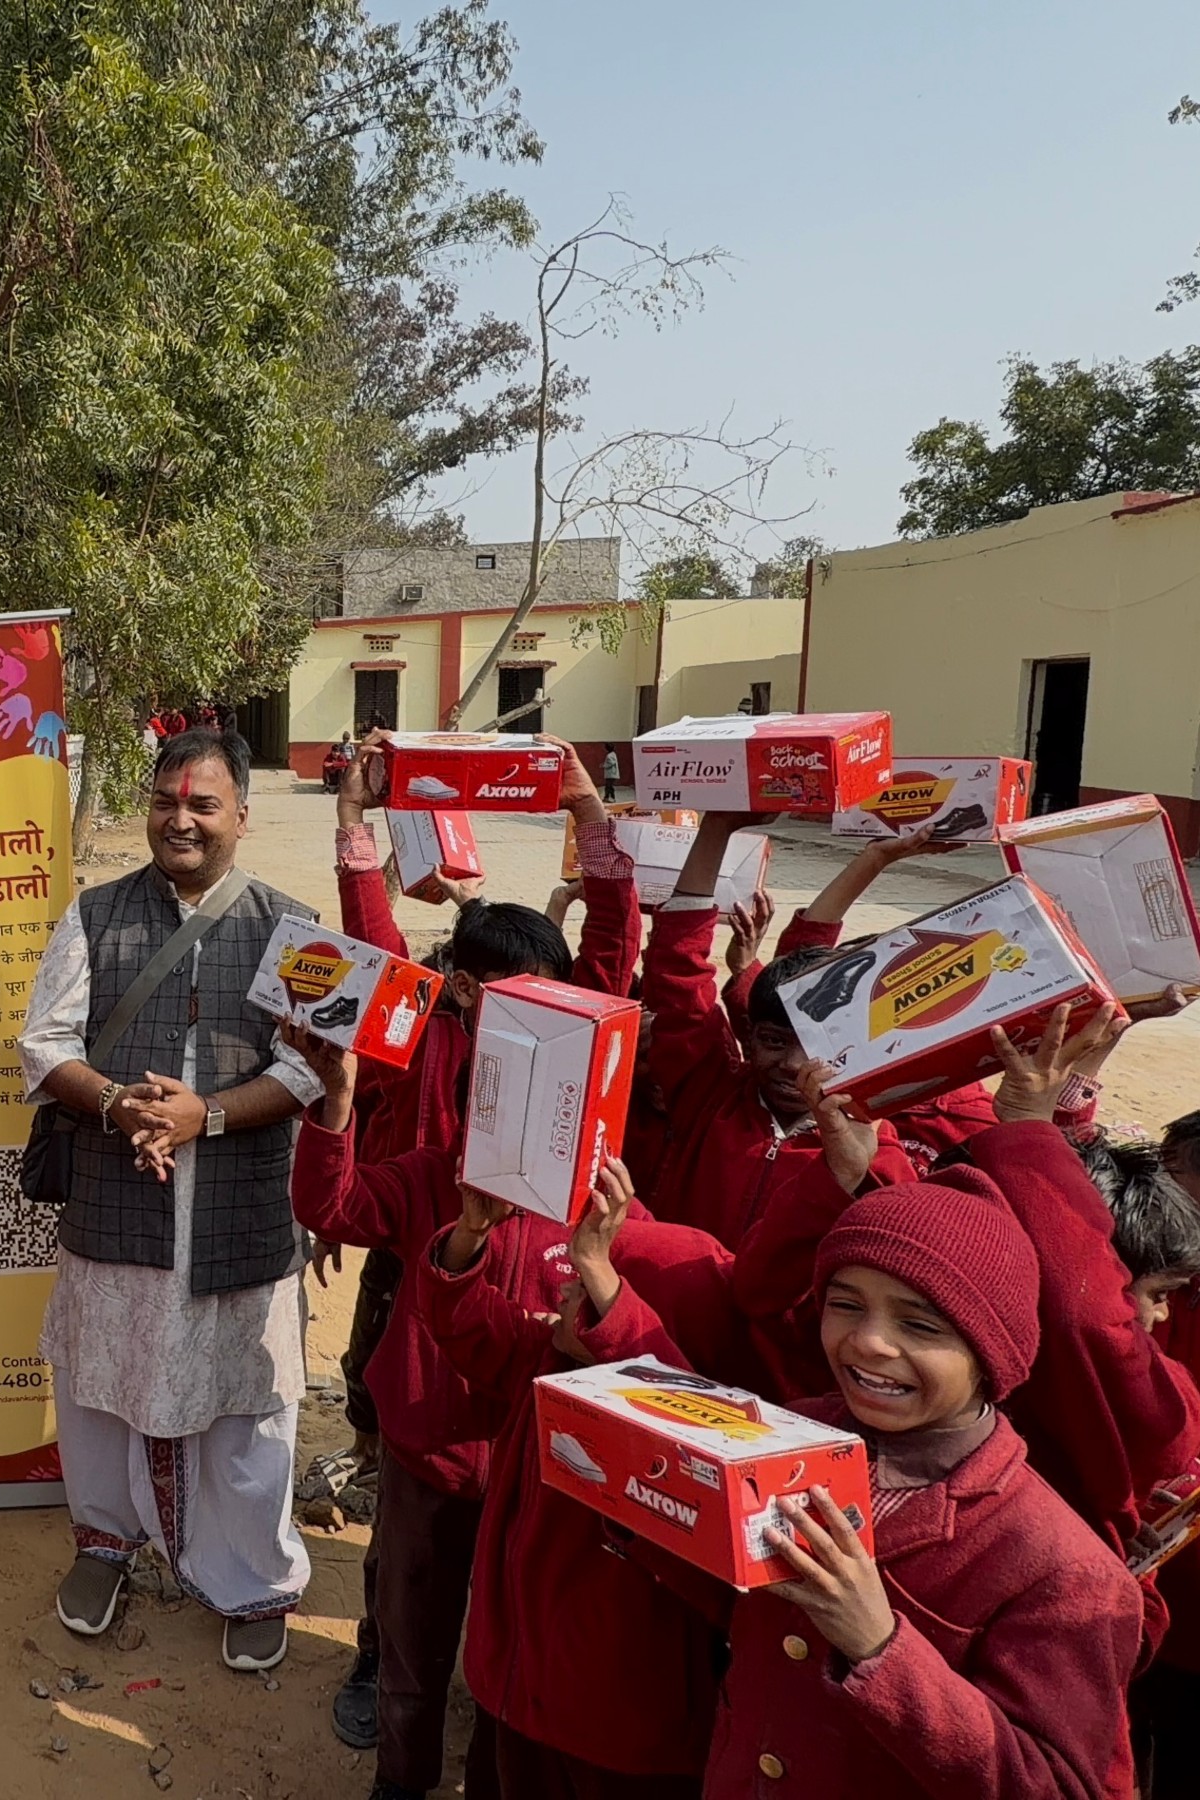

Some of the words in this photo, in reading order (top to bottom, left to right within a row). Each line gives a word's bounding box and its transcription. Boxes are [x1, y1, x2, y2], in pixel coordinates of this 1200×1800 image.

[770, 744, 794, 756] Back
[846, 738, 882, 765] AirFlow
[648, 761, 732, 777] AirFlow
[475, 784, 537, 798] Axrow
[653, 791, 681, 801] APH
[878, 786, 934, 803] Axrow
[17, 921, 41, 936] एक
[0, 950, 15, 965] के
[912, 949, 942, 968] School
[292, 958, 335, 977] Axrow
[886, 966, 912, 983] Shoes
[5, 981, 27, 997] पूरा
[894, 954, 974, 1013] Axrow
[0, 1091, 10, 1105] में
[589, 1118, 606, 1190] Axrow
[2, 1356, 49, 1368] Contac
[646, 1395, 736, 1425] Axrow
[624, 1475, 699, 1530] Axrow
